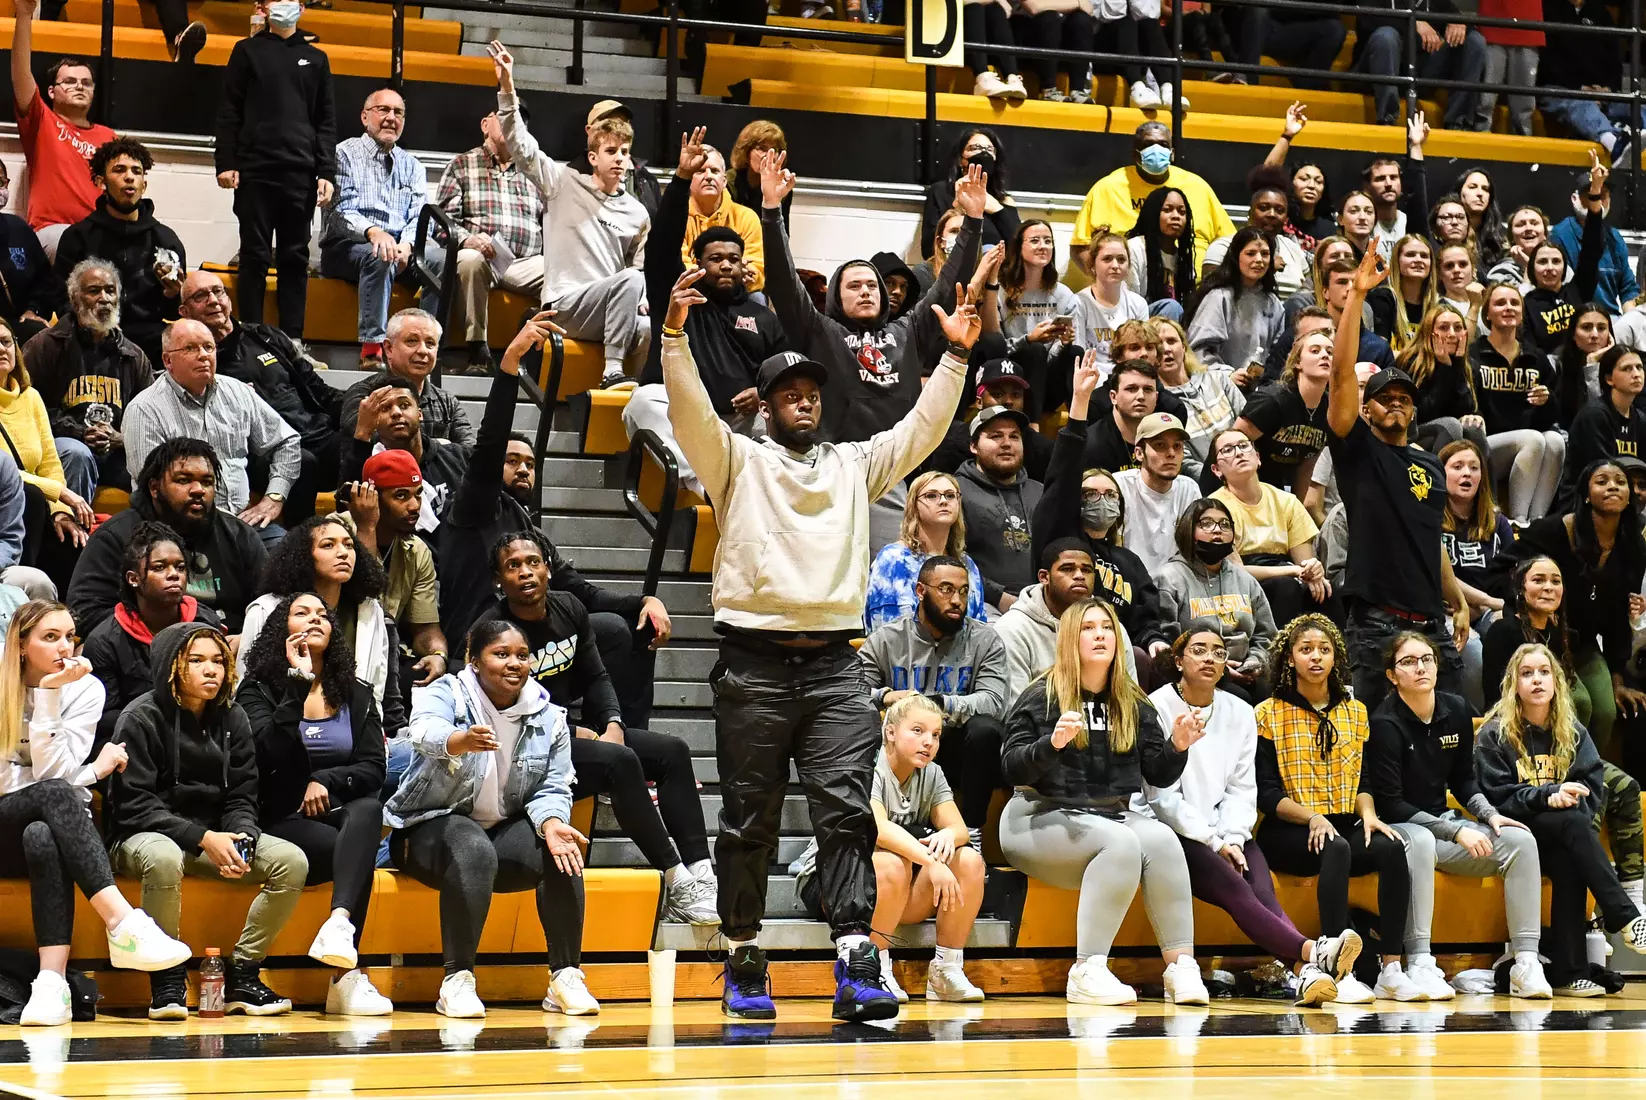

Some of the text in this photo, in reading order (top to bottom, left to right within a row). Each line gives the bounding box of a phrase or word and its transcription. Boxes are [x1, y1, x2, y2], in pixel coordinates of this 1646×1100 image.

[912, 0, 958, 58] D
[1480, 366, 1541, 392] VILLE
[893, 666, 972, 693] DUKE
